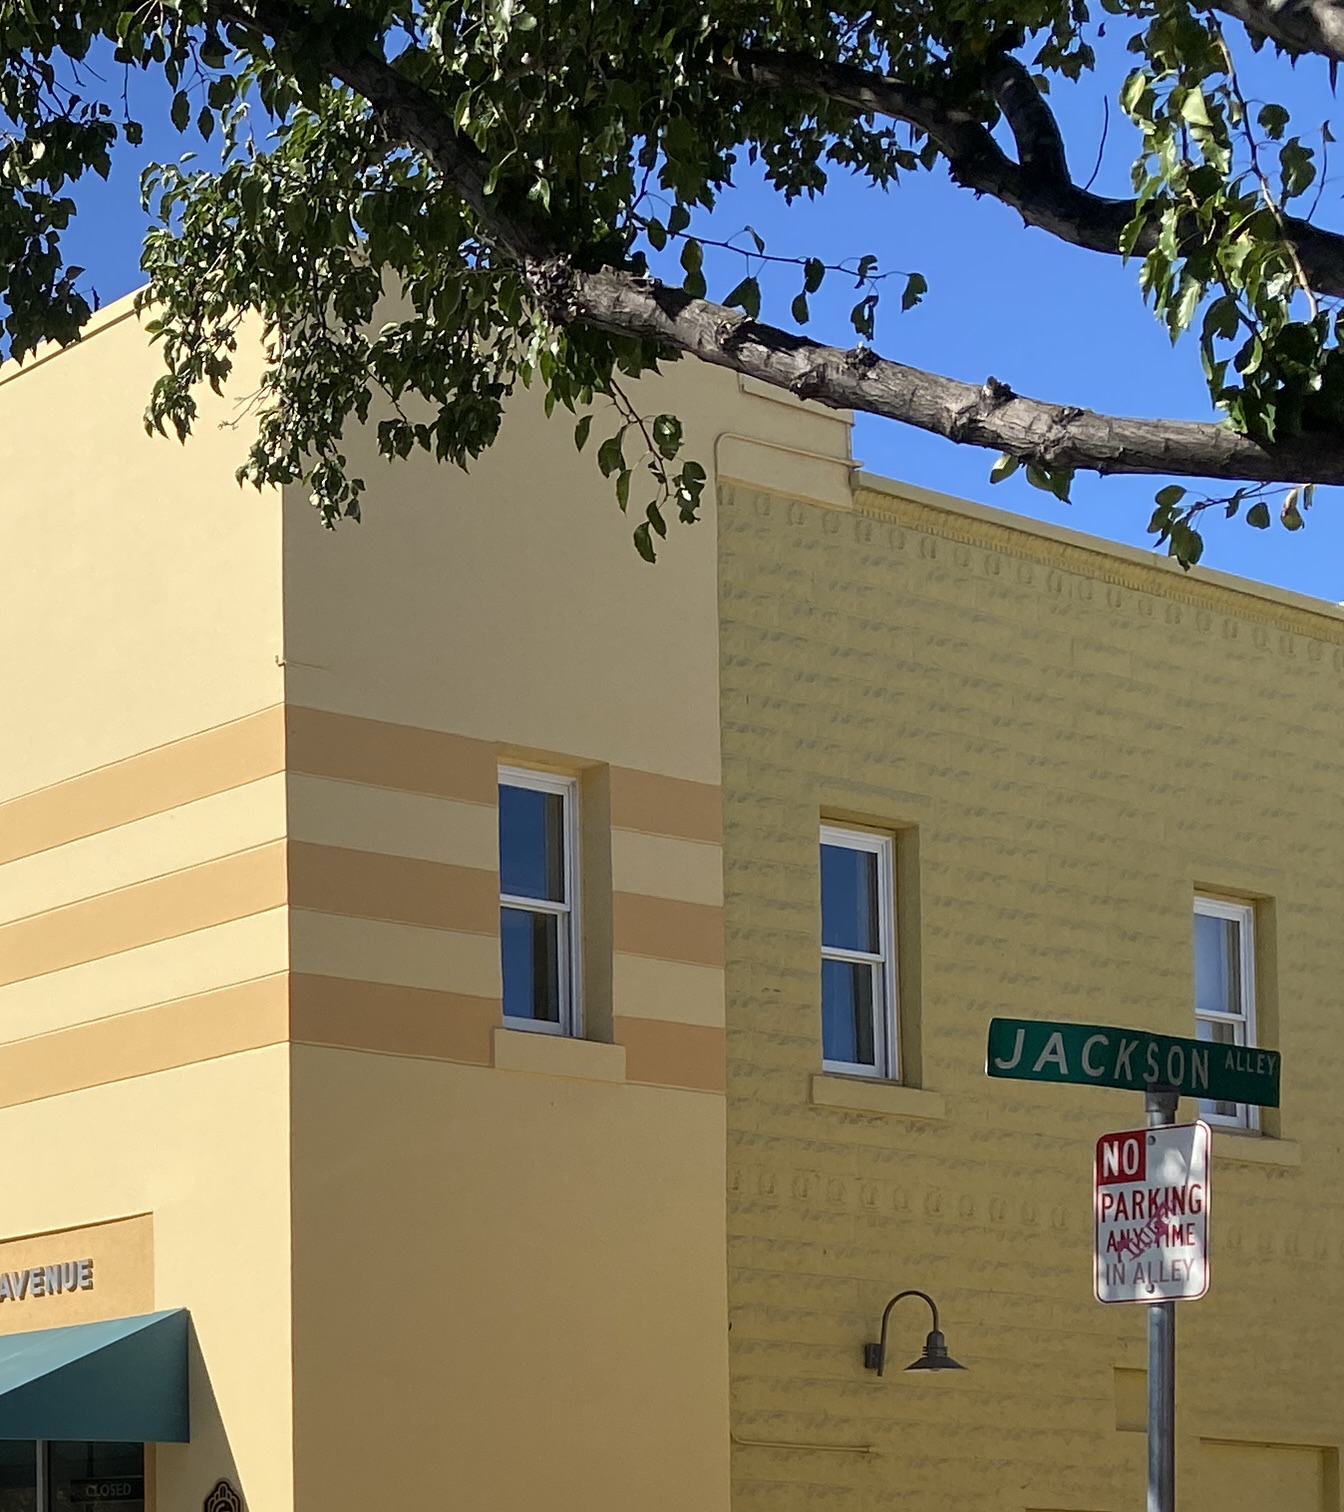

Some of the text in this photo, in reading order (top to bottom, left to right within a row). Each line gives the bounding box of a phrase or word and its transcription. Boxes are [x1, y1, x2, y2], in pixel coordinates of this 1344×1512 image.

[994, 1028, 1277, 1089] JACKSON ALLEY
[1103, 1138, 1140, 1178] NO
[1101, 1184, 1202, 1223] PARKING
[1106, 1257, 1196, 1286] IN ALLEY
[85, 1482, 132, 1499] CLOSED
